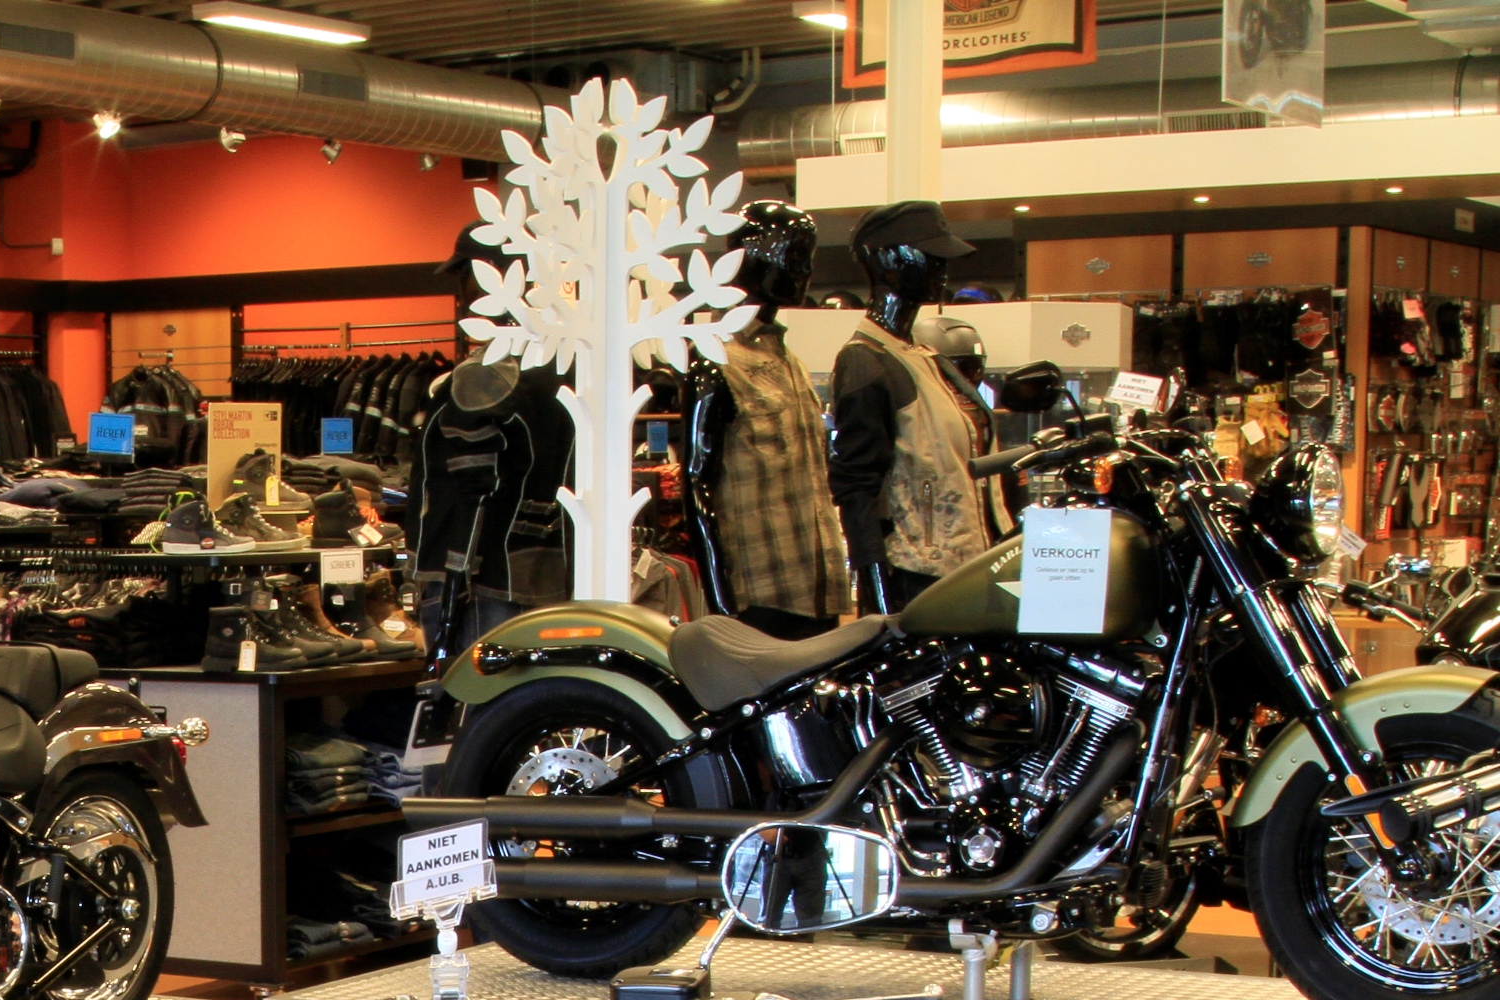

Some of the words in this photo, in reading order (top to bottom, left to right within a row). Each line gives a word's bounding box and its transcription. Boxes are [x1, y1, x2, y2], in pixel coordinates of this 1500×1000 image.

[944, 12, 979, 26] MERICAN
[980, 5, 1009, 23] LEGEND
[943, 31, 1028, 50] ORCLOTHES
[213, 410, 252, 420] STYLMARTIN
[96, 426, 126, 440] HEREN
[213, 429, 250, 439] COLLECTION
[990, 545, 1022, 574] HARL
[1032, 547, 1100, 559] VERKOCHT
[1079, 567, 1088, 575] op
[428, 834, 458, 850] NIET
[406, 849, 479, 875] AANKOMEN
[426, 872, 463, 890] A.U.B.
